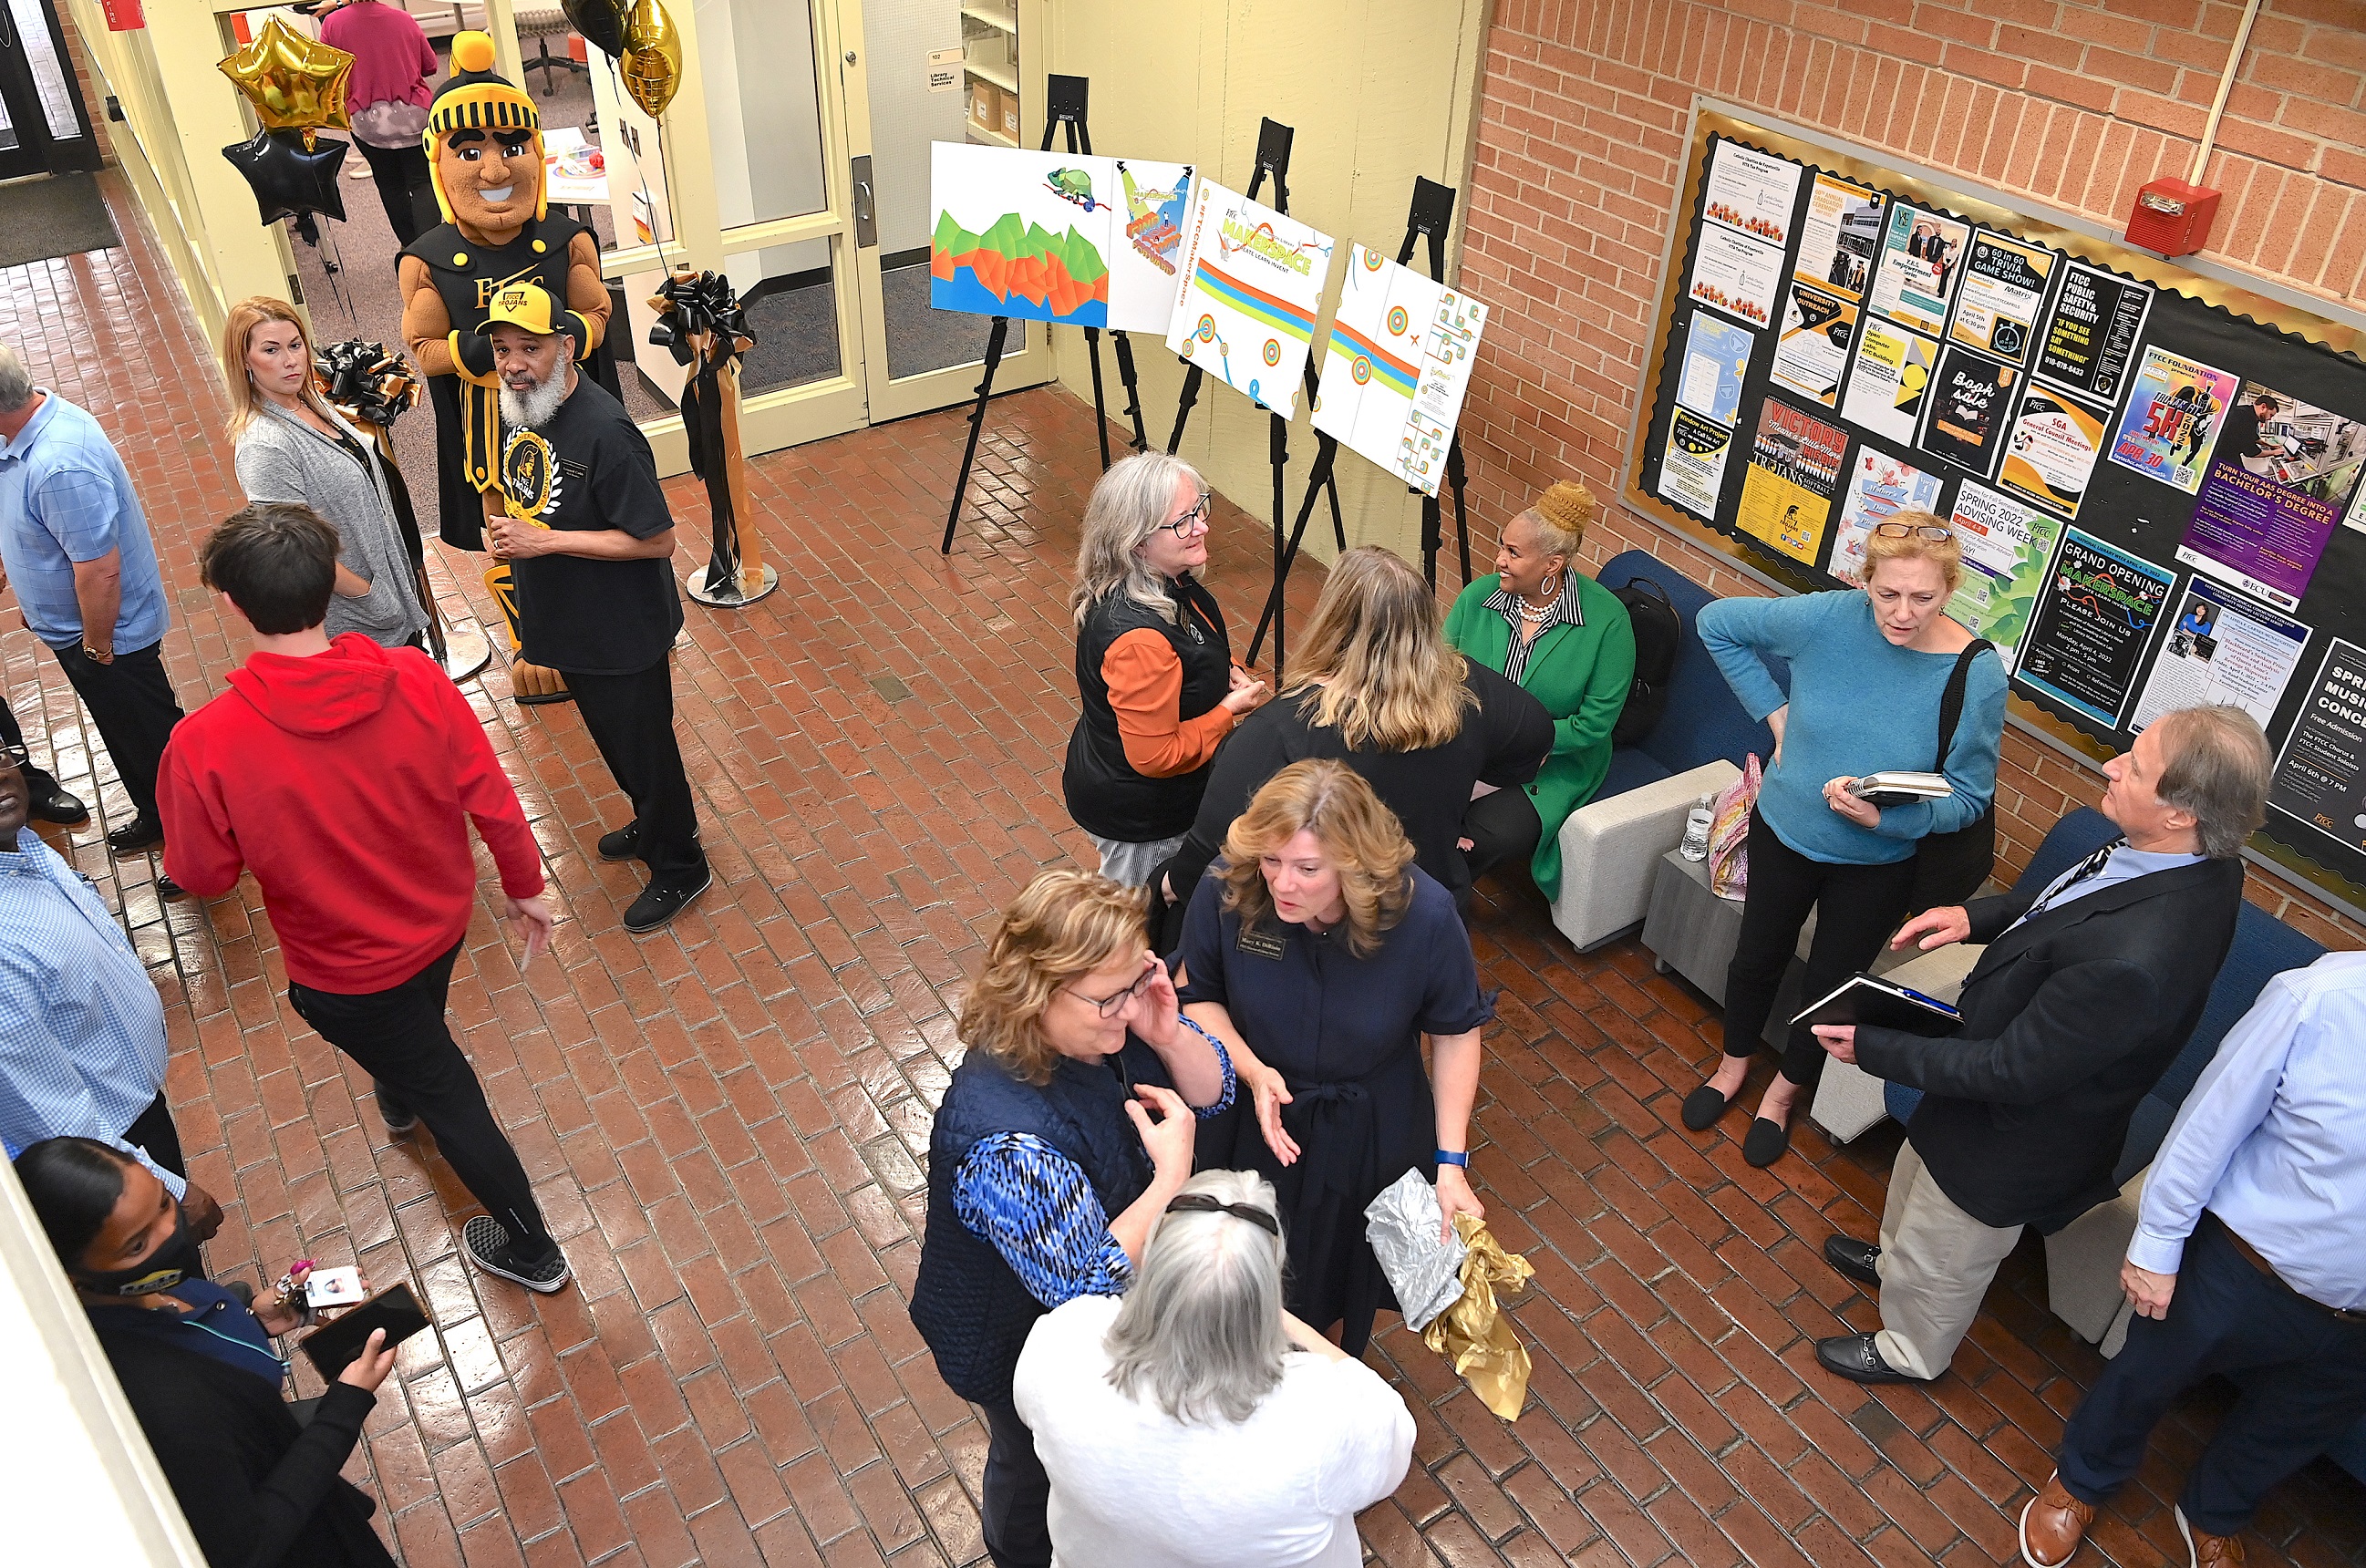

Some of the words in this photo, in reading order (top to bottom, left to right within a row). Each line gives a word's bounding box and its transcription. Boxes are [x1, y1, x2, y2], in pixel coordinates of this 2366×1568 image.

[106, 1, 117, 24] FIRE
[1812, 200, 1837, 213] CEREMONY
[1813, 194, 1843, 209] GRADUATION
[1824, 191, 1844, 202] ANNUAL
[2183, 212, 2196, 243] FIRE
[1223, 217, 1313, 276] MAKERSPACE
[1991, 248, 2000, 257] 60
[2003, 252, 2012, 261] in
[2012, 254, 2025, 265] 60
[1255, 253, 1271, 264] LEARN
[1271, 261, 1289, 273] INVENT
[1892, 258, 1932, 278] Empowerment
[1903, 268, 1917, 278] Series
[1990, 256, 2022, 273] TRIVIA
[1974, 260, 2000, 276] GAME
[2001, 269, 2035, 288] SHOW!
[2069, 271, 2090, 287] FTCC
[1799, 289, 1835, 307] UNIVERSITY
[2065, 281, 2095, 301] PUBLIC
[1796, 297, 1830, 315] OUTREACH
[2062, 292, 2097, 313] SAFETY&
[1962, 309, 1975, 318] April
[1975, 314, 1985, 322] 5th
[2059, 302, 2099, 325] SECURITY
[1832, 325, 1848, 339] FTCC
[1866, 329, 1880, 339] Open
[1868, 320, 1882, 332] FTCC
[2052, 325, 2089, 346] SOMETHING
[2064, 320, 2078, 332] YOU
[2078, 325, 2090, 336] SEE
[1863, 342, 1876, 350] Labs:
[1865, 335, 1889, 349] Computer
[2050, 335, 2062, 345] SAY
[1872, 352, 1893, 365] Building
[2148, 351, 2168, 363] FTCC
[2167, 358, 2218, 381] FOUNDATION
[1951, 369, 1997, 398] Book
[1952, 384, 1990, 409] sale
[2029, 397, 2046, 412] FTCC
[2154, 390, 2186, 410] TROJAN
[1679, 413, 1700, 428] Window
[1700, 422, 1708, 431] Art
[1709, 426, 1728, 442] Project
[1768, 401, 1846, 454] VICTORY
[2051, 418, 2067, 430] SGA
[2142, 400, 2185, 442] 5K
[1697, 430, 1705, 438] Call
[1767, 418, 1793, 438] Means
[1798, 433, 1820, 450] Little
[1819, 443, 1842, 460] More
[2022, 418, 2044, 431] General
[2044, 428, 2065, 440] Council
[2065, 436, 2092, 451] Meetings
[2117, 440, 2144, 460] APR.
[2144, 451, 2163, 469] 30
[1751, 451, 1803, 486] TROJANS
[1803, 477, 1830, 494] SOFTBALL
[2216, 462, 2237, 475] TURN
[2237, 470, 2259, 484] YOUR
[2259, 480, 2276, 490] AAS
[2275, 487, 2306, 503] DEGREE
[2306, 500, 2327, 512] INTO
[1962, 482, 1980, 495] Prepare
[1980, 490, 1989, 499] for
[1998, 499, 2020, 513] Semester
[2213, 469, 2283, 504] BACHELOR'S
[2283, 499, 2330, 524] DEGREE
[1873, 503, 1887, 513] Day
[1958, 490, 1997, 515] SPRING
[1998, 508, 2023, 527] 2022
[1779, 519, 1798, 531] TROJANS
[1955, 501, 2005, 532] ADVISING
[2006, 525, 2037, 547] WEEK
[1956, 516, 1970, 527] April
[1971, 522, 1981, 531] 4-8
[2030, 521, 2051, 539] FTCC
[2182, 551, 2197, 562] FTCC
[2063, 542, 2106, 570] GRAND
[2107, 562, 2165, 598] OPENING
[2059, 562, 2153, 616] MAKERSPACE
[2249, 583, 2268, 595] ECU
[2094, 592, 2111, 603] LEARN
[2111, 600, 2130, 612] INVENT
[2060, 597, 2092, 618] PLEASE
[2093, 614, 2116, 630] JOIN
[2035, 646, 2055, 661] Activities
[2055, 630, 2078, 646] Monday,
[2078, 642, 2092, 654] April
[2097, 652, 2112, 663] 2022
[2069, 646, 2079, 655] pm
[2086, 655, 2096, 665] pm
[2223, 645, 2249, 660] Excavation
[2249, 656, 2259, 665] and
[2258, 661, 2279, 675] Analysis
[2223, 656, 2244, 669] Revenge
[2235, 656, 2252, 667] Queen
[2252, 651, 2272, 664] Sunken
[2066, 664, 2080, 674] Prizes
[2227, 665, 2241, 675] April
[2091, 676, 2121, 696] Refreshments
[2309, 712, 2326, 726] Free
[2325, 720, 2363, 743] Admission
[2302, 730, 2313, 739] The
[2313, 736, 2329, 747] FTCC
[2328, 743, 2350, 757] Chorus
[2299, 738, 2313, 748] FTCC
[2313, 744, 2336, 760] Student
[2336, 756, 2360, 771] Soloists
[2287, 758, 2307, 773] April
[2306, 768, 2320, 779] 6th
[2333, 781, 2347, 792] PM
